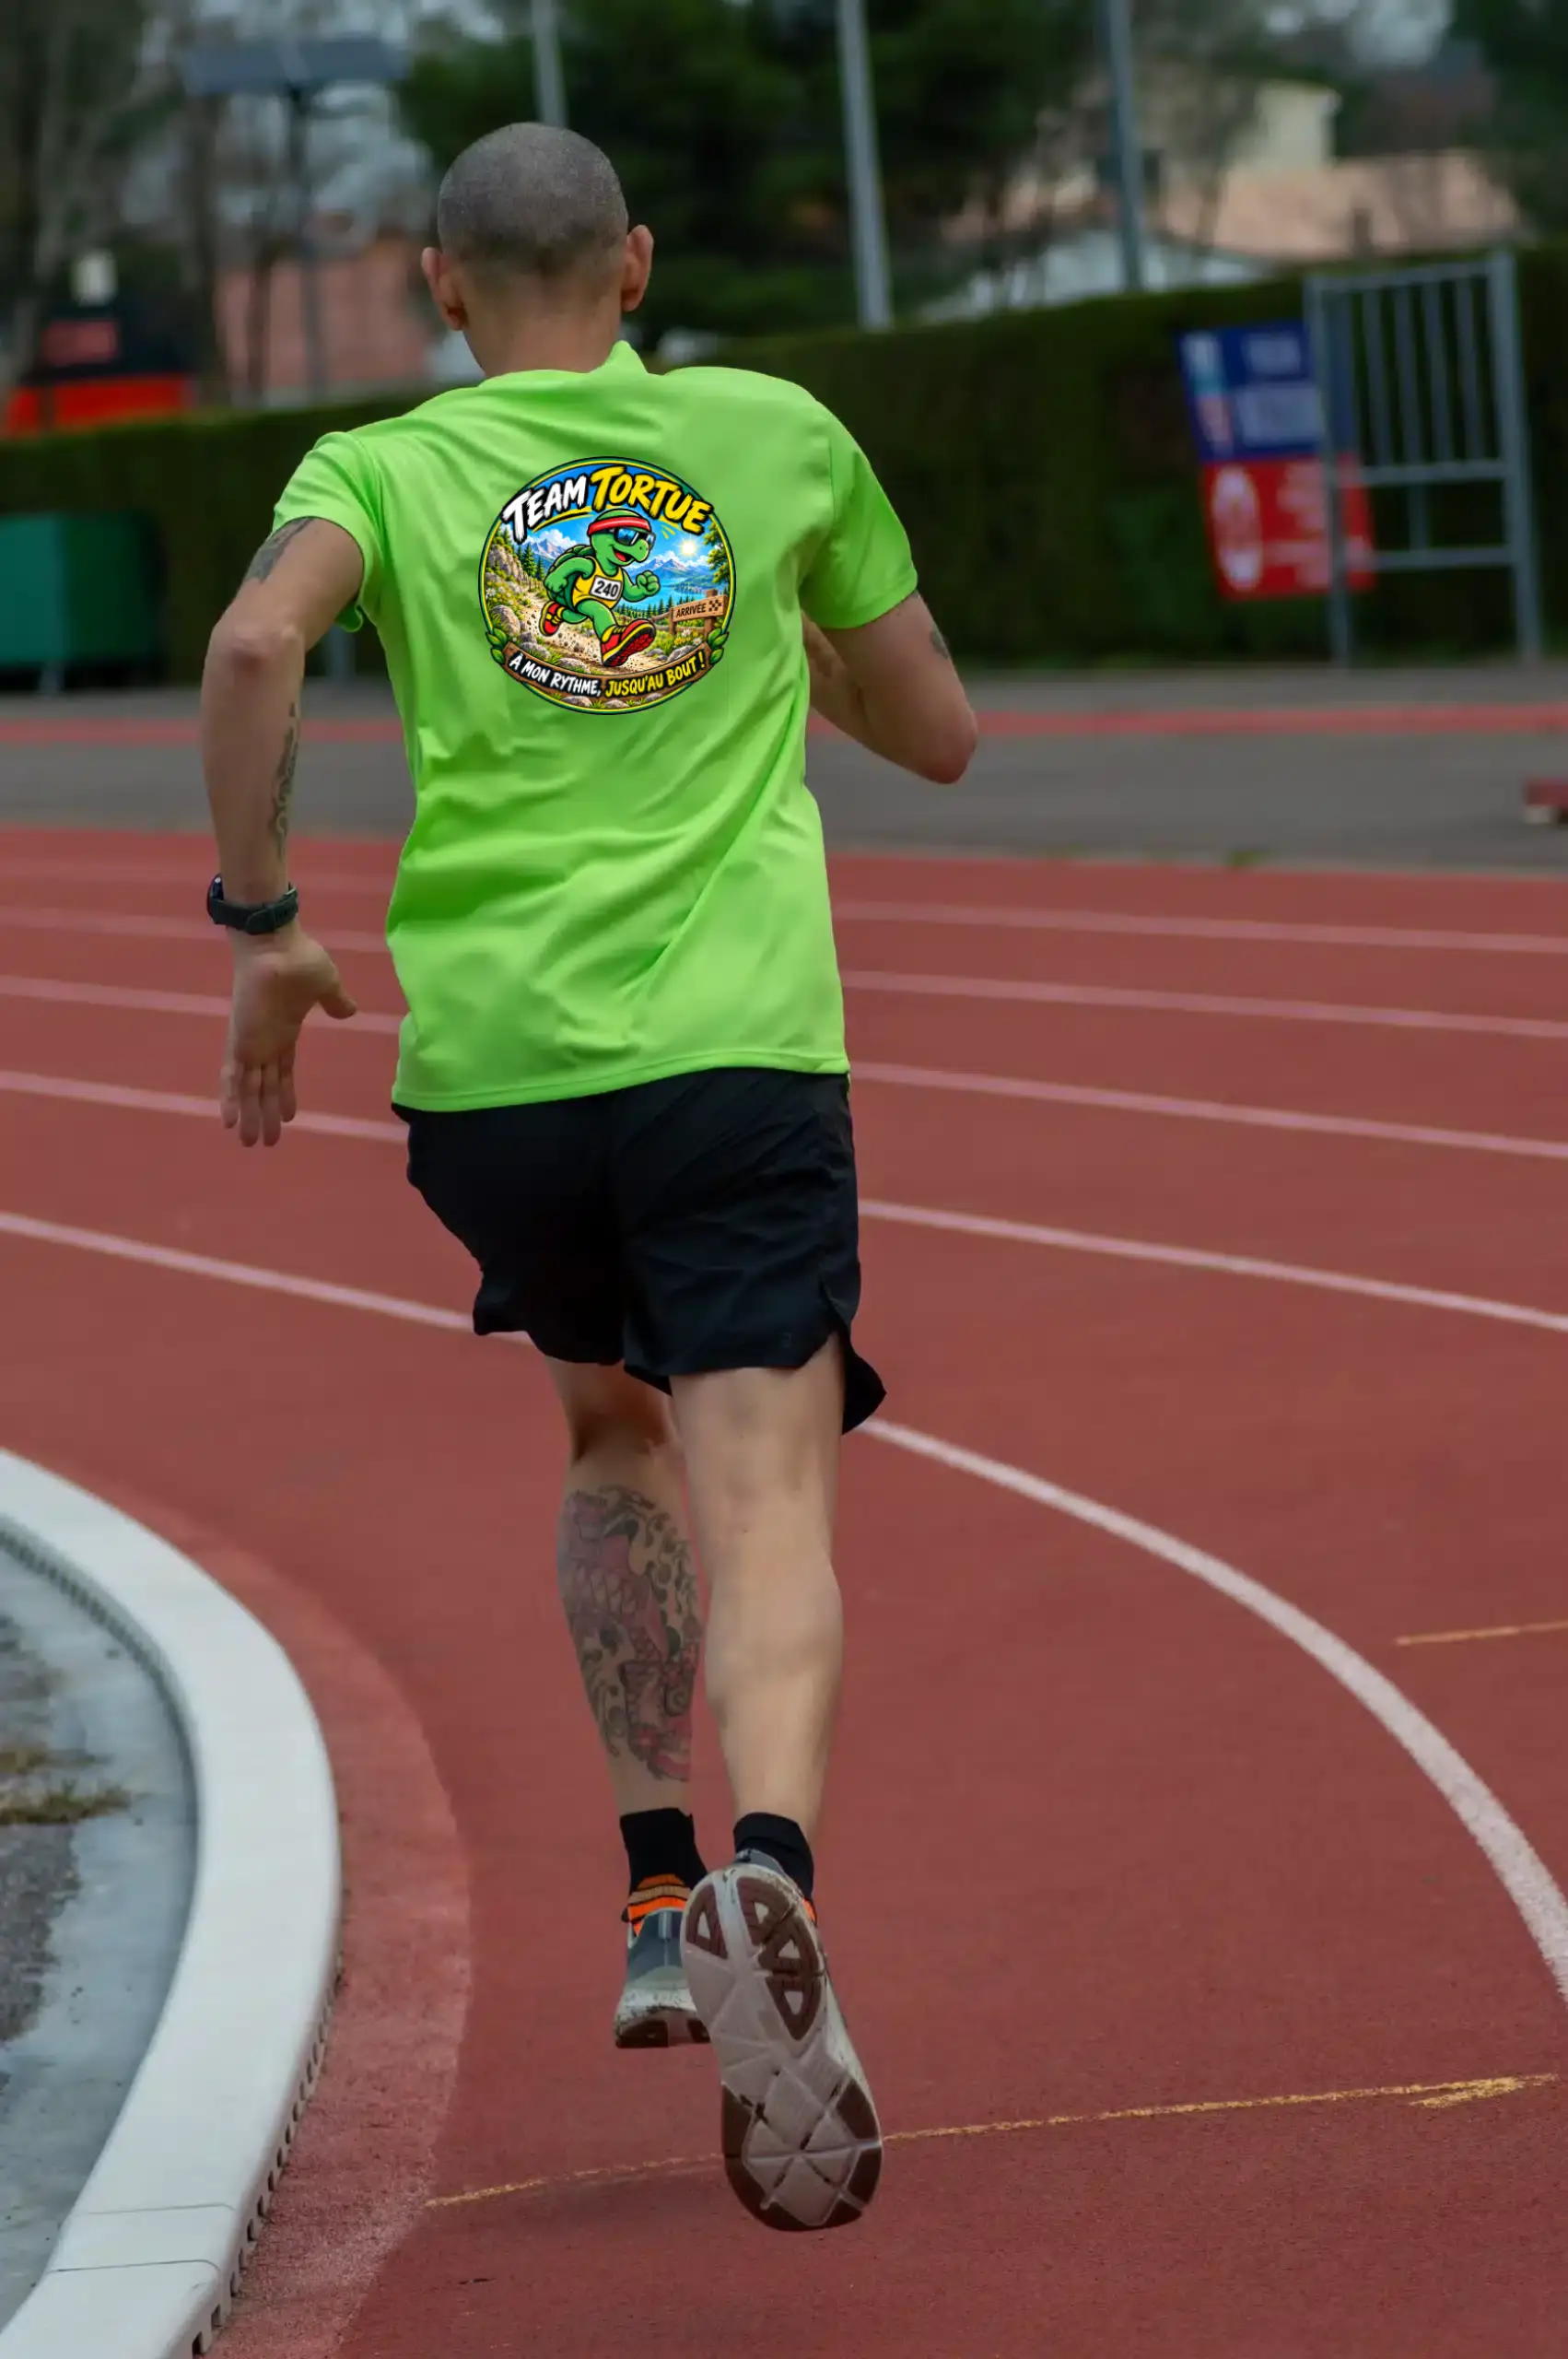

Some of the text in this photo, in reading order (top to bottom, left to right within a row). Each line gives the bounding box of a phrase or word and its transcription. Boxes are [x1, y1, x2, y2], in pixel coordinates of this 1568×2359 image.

[502, 465, 713, 543] TEAM TORTUE
[594, 580, 619, 597] 240
[521, 661, 550, 684] MON
[550, 672, 602, 698] RYTHME,
[605, 673, 663, 698] JUSQU'AU
[665, 655, 697, 687] BOUT
